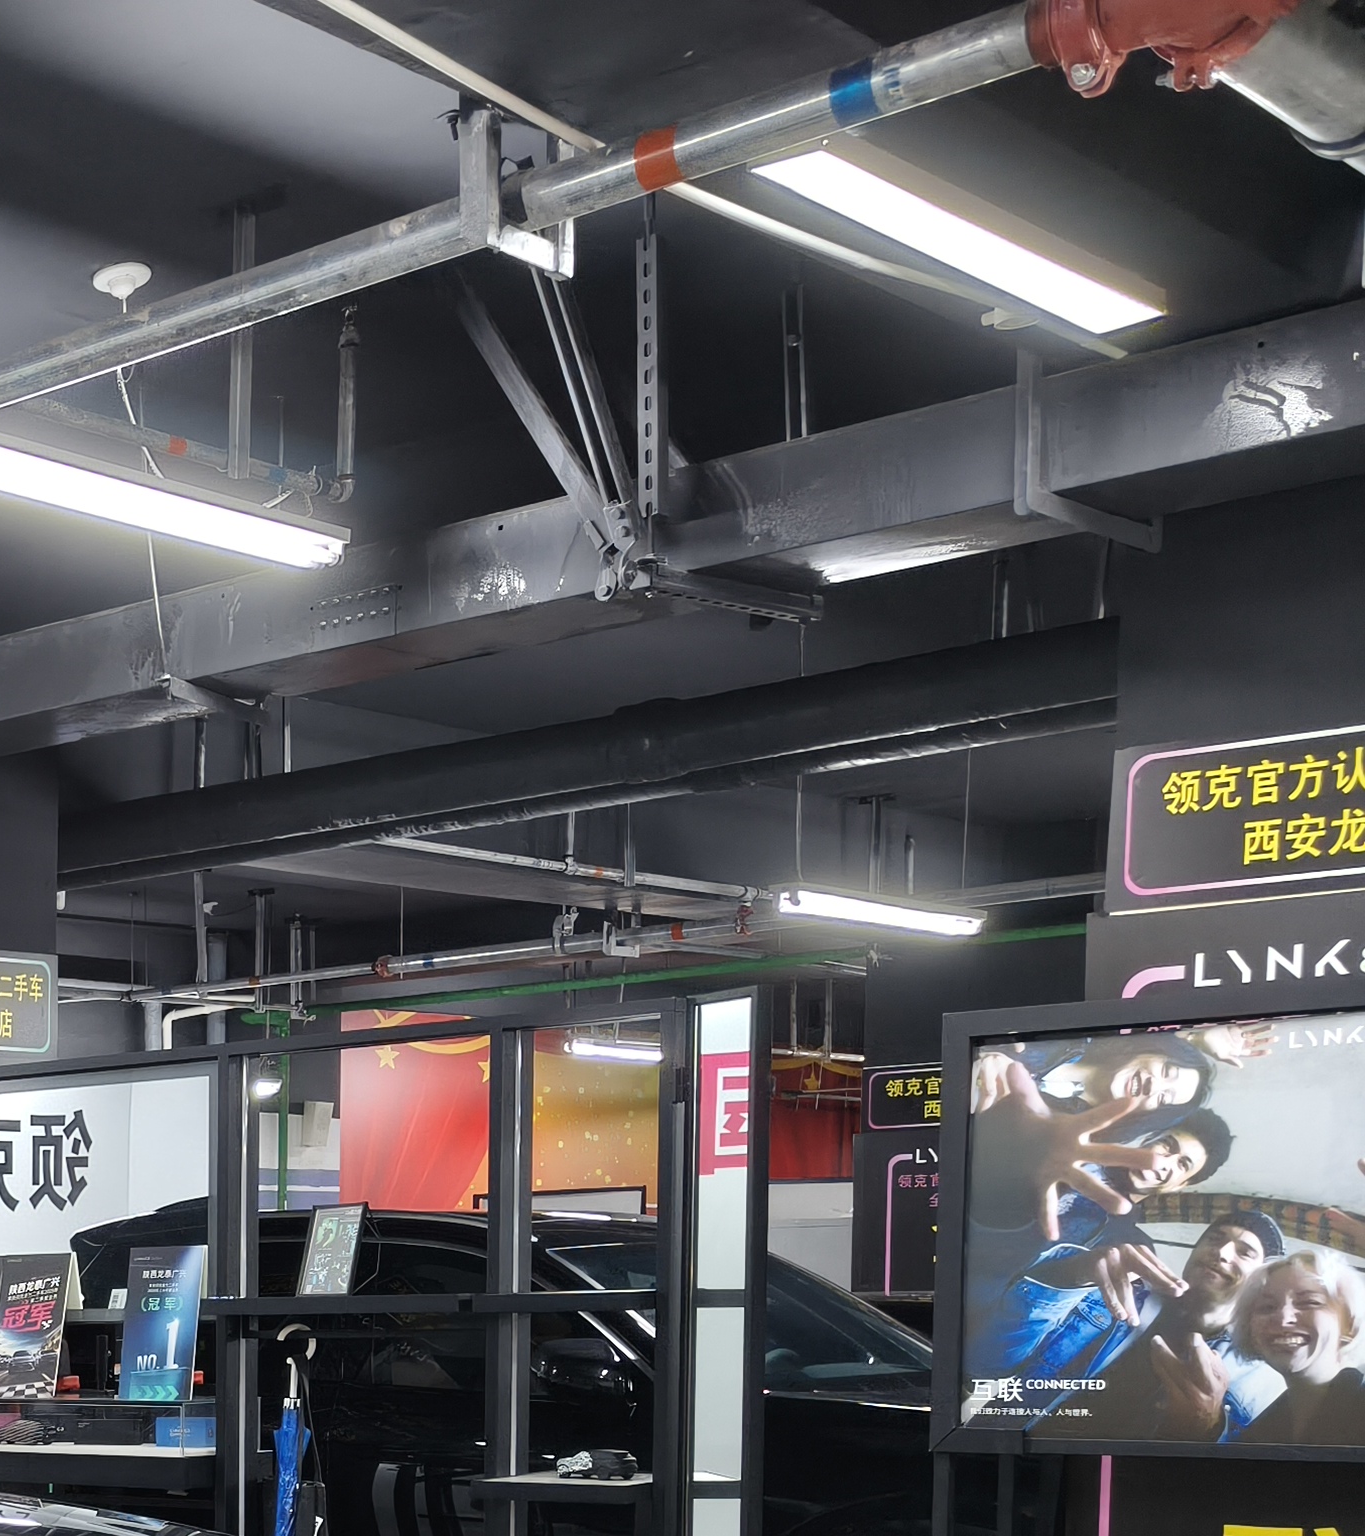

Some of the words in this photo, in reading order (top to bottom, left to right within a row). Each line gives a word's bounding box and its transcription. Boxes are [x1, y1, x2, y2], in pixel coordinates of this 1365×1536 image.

[1161, 746, 1365, 815] 领克官方认
[1243, 808, 1365, 866] 西安龙
[1193, 938, 1365, 988] LYNK
[923, 1100, 942, 1118] 西
[2, 1301, 56, 1333] 冠军
[970, 1377, 1024, 1402] 互联
[1025, 1379, 1106, 1391] CONNECTED
